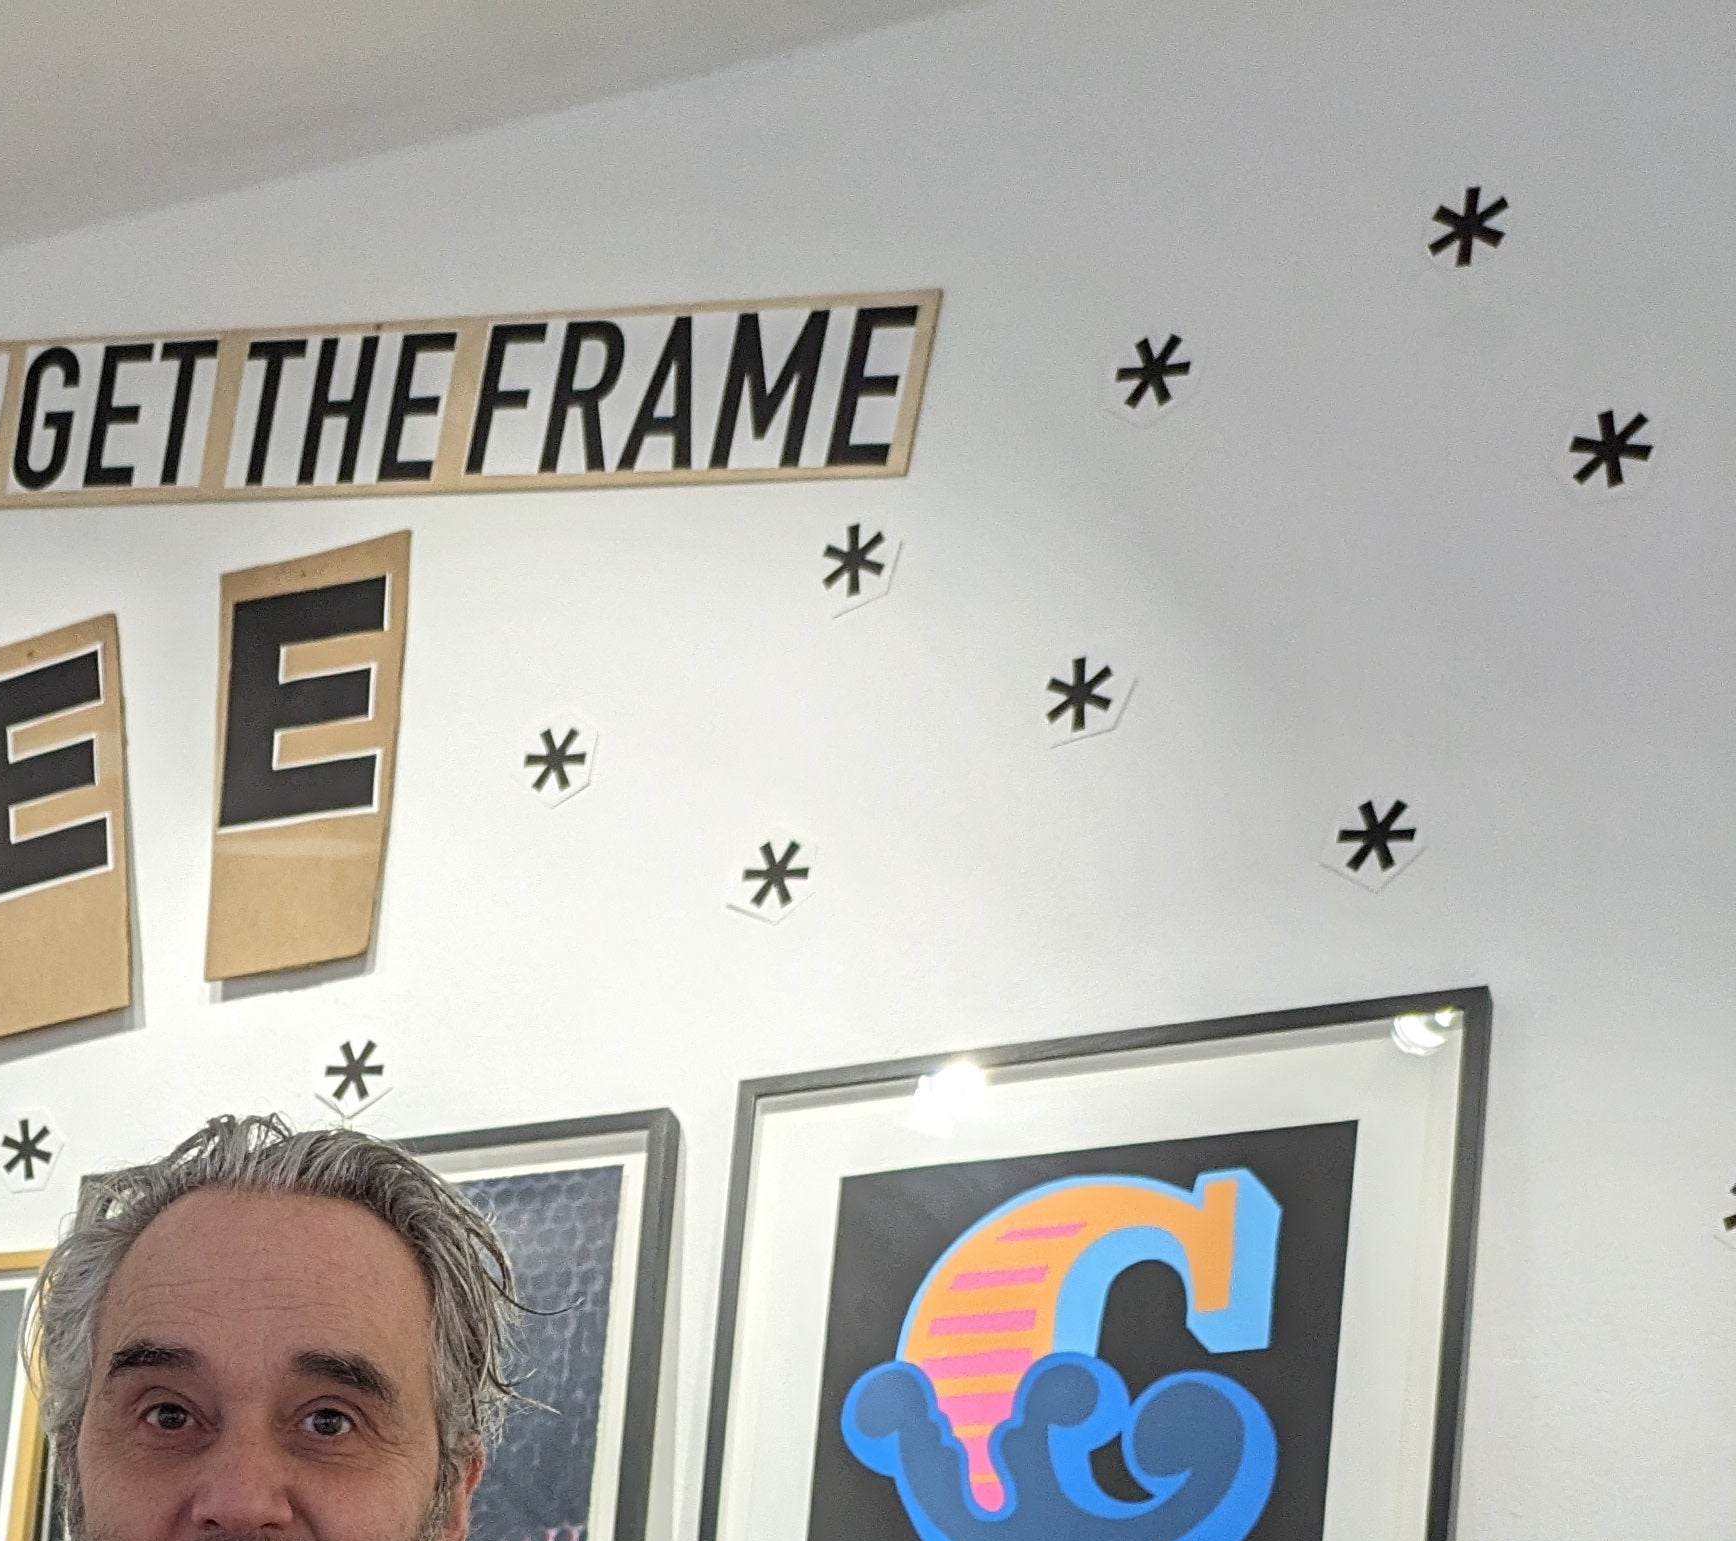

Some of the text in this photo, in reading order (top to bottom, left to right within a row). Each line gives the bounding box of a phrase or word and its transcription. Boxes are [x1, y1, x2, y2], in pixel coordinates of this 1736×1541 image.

[12, 339, 219, 492] GET
[245, 331, 458, 488] THE
[465, 304, 920, 475] FRAME
